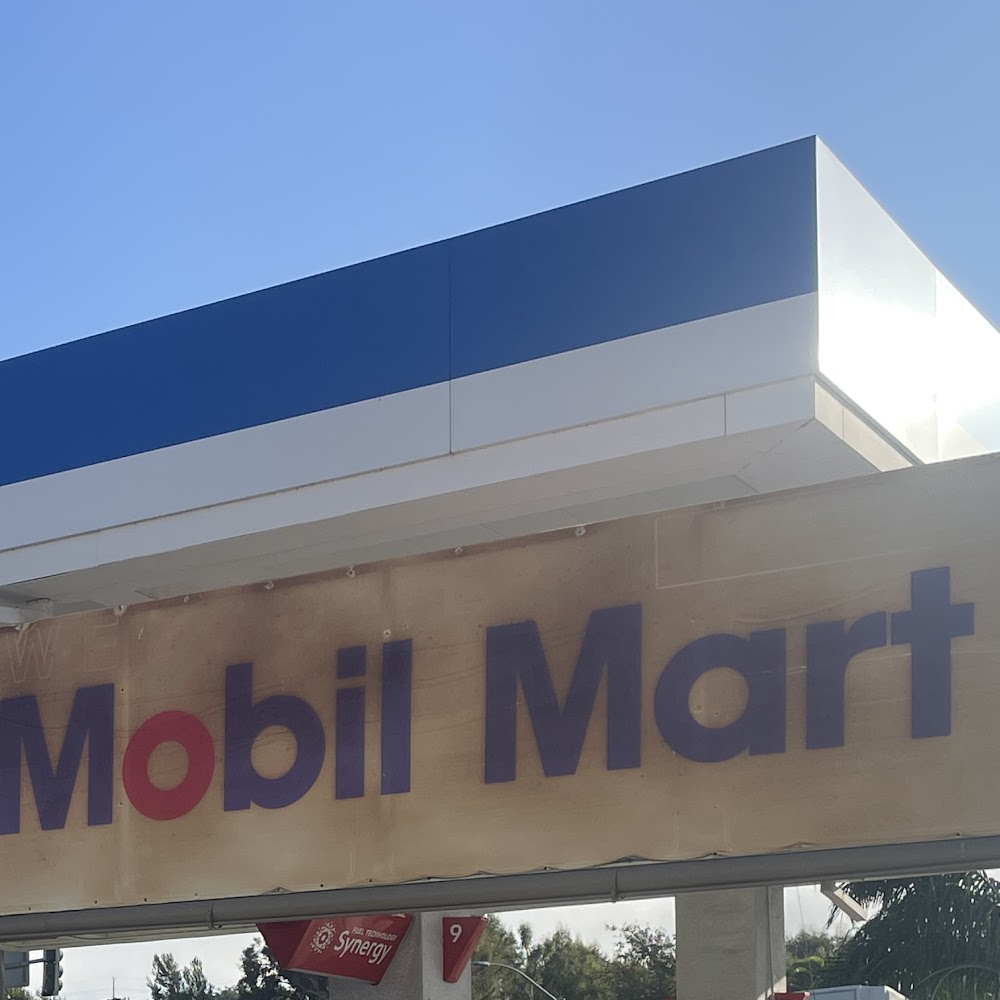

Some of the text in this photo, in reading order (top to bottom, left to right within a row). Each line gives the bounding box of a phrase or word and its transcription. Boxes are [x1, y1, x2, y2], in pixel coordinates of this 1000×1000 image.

[484, 566, 976, 785] Mart
[366, 929, 398, 941] TECHNOLOGY
[450, 924, 462, 943] 9
[333, 930, 392, 965] Synergy
